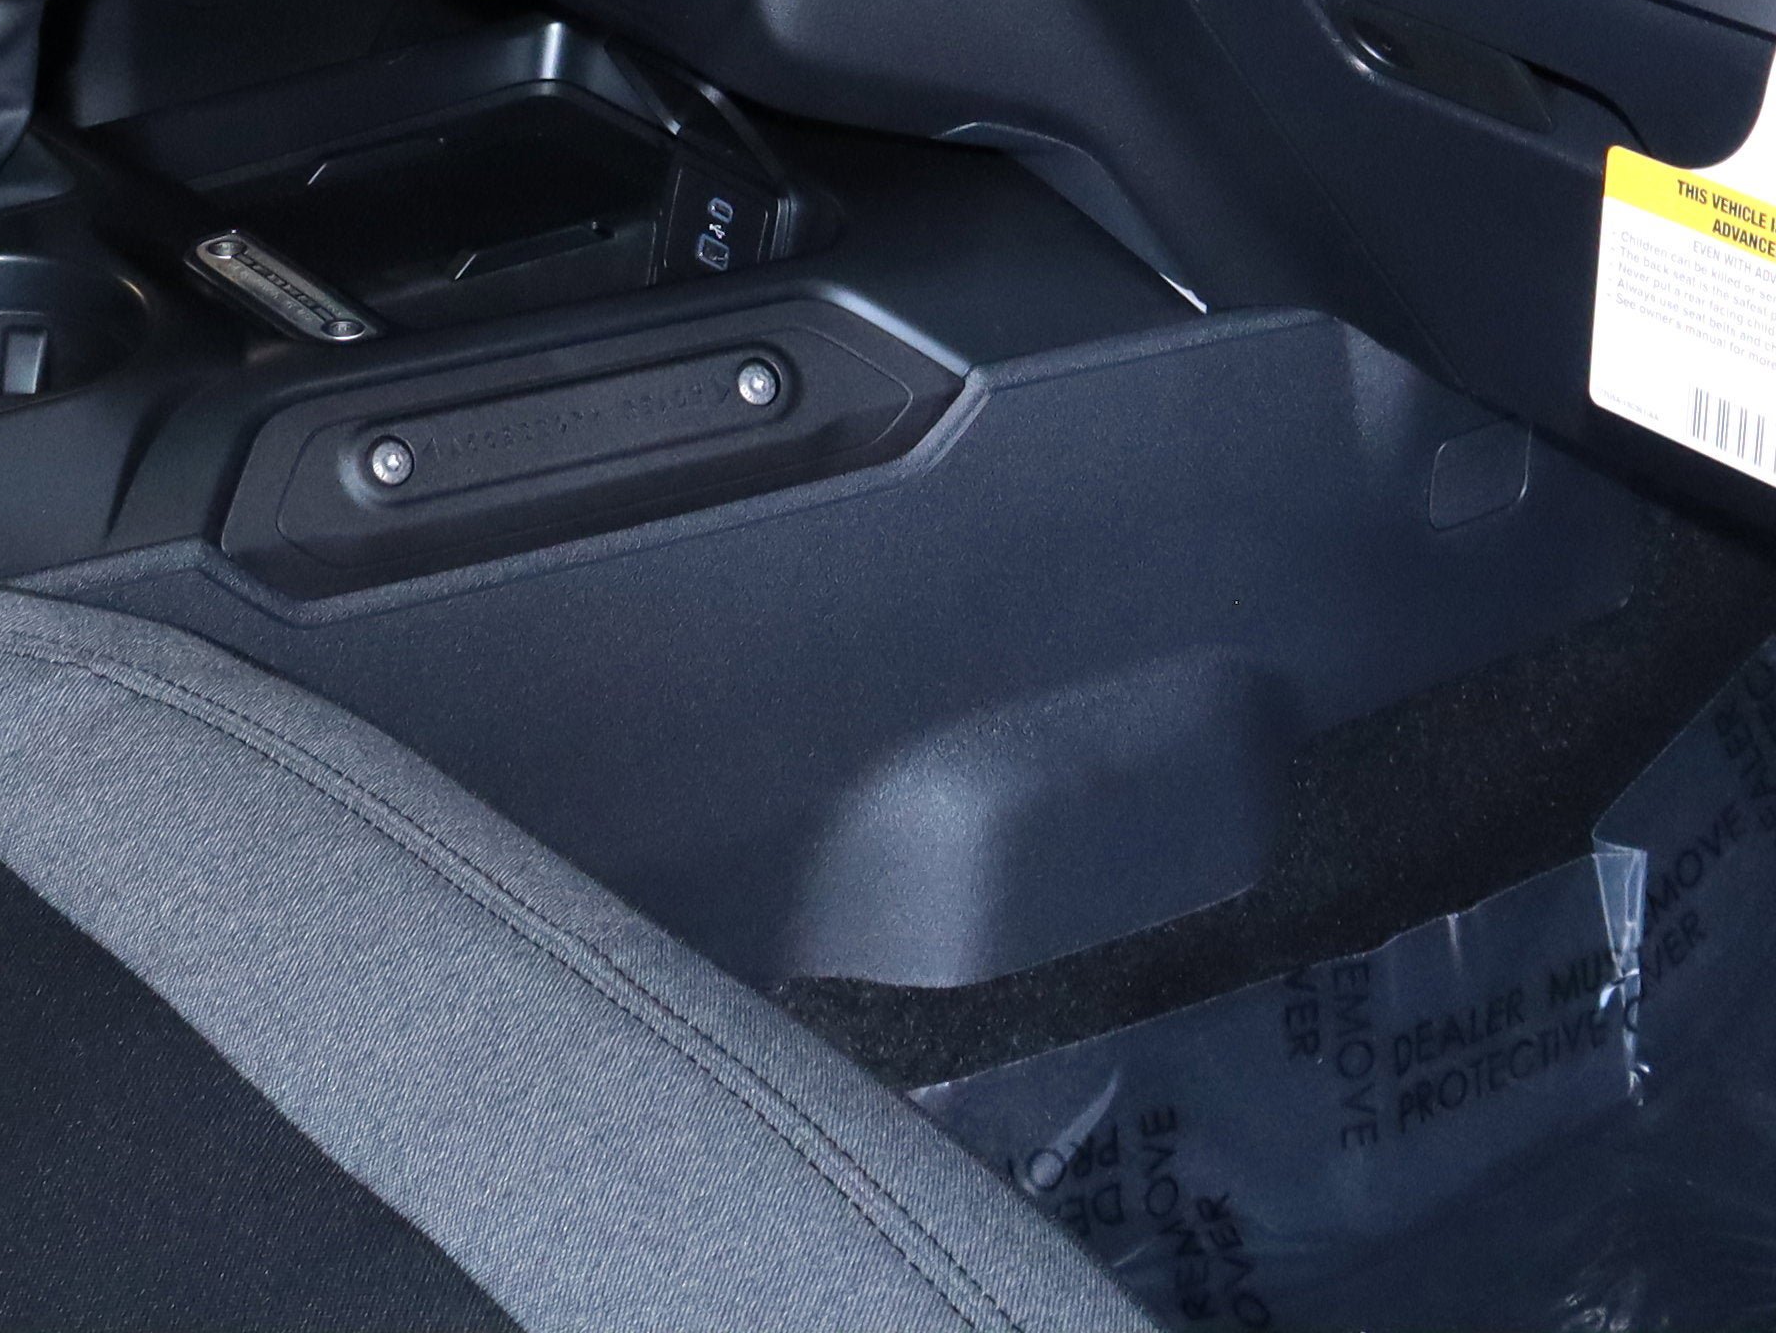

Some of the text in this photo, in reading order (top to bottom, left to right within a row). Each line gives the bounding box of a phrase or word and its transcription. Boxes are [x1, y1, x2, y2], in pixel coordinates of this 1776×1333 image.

[1676, 179, 1708, 205] THIS
[1712, 192, 1767, 230] VEHICLE
[1620, 231, 1668, 259] Children
[1671, 253, 1691, 268] can
[1695, 261, 1708, 275] be
[1711, 268, 1741, 289] killed
[1744, 284, 1756, 296] or
[1620, 245, 1640, 263] The
[1644, 257, 1670, 275] back
[1674, 271, 1696, 288] seat
[1700, 281, 1709, 293] is
[1712, 286, 1730, 301] the
[1734, 297, 1768, 318] safest
[1693, 240, 1721, 262] EVEN
[1724, 253, 1751, 273] WITH
[1616, 293, 1636, 311] See
[1685, 325, 1727, 349] manual
[1730, 341, 1746, 357] for
[1618, 262, 1650, 283] Never
[1653, 278, 1672, 295] put
[1684, 291, 1706, 306] rear
[1710, 300, 1744, 326] facing
[1747, 317, 1776, 337] child
[1618, 277, 1656, 303] Always
[1659, 298, 1680, 313] use
[1683, 307, 1706, 325] seat
[1709, 317, 1736, 338] belts
[1740, 331, 1762, 347] and
[1393, 987, 1526, 1078] DEALER
[1398, 1005, 1612, 1134] PROTECTIVE
